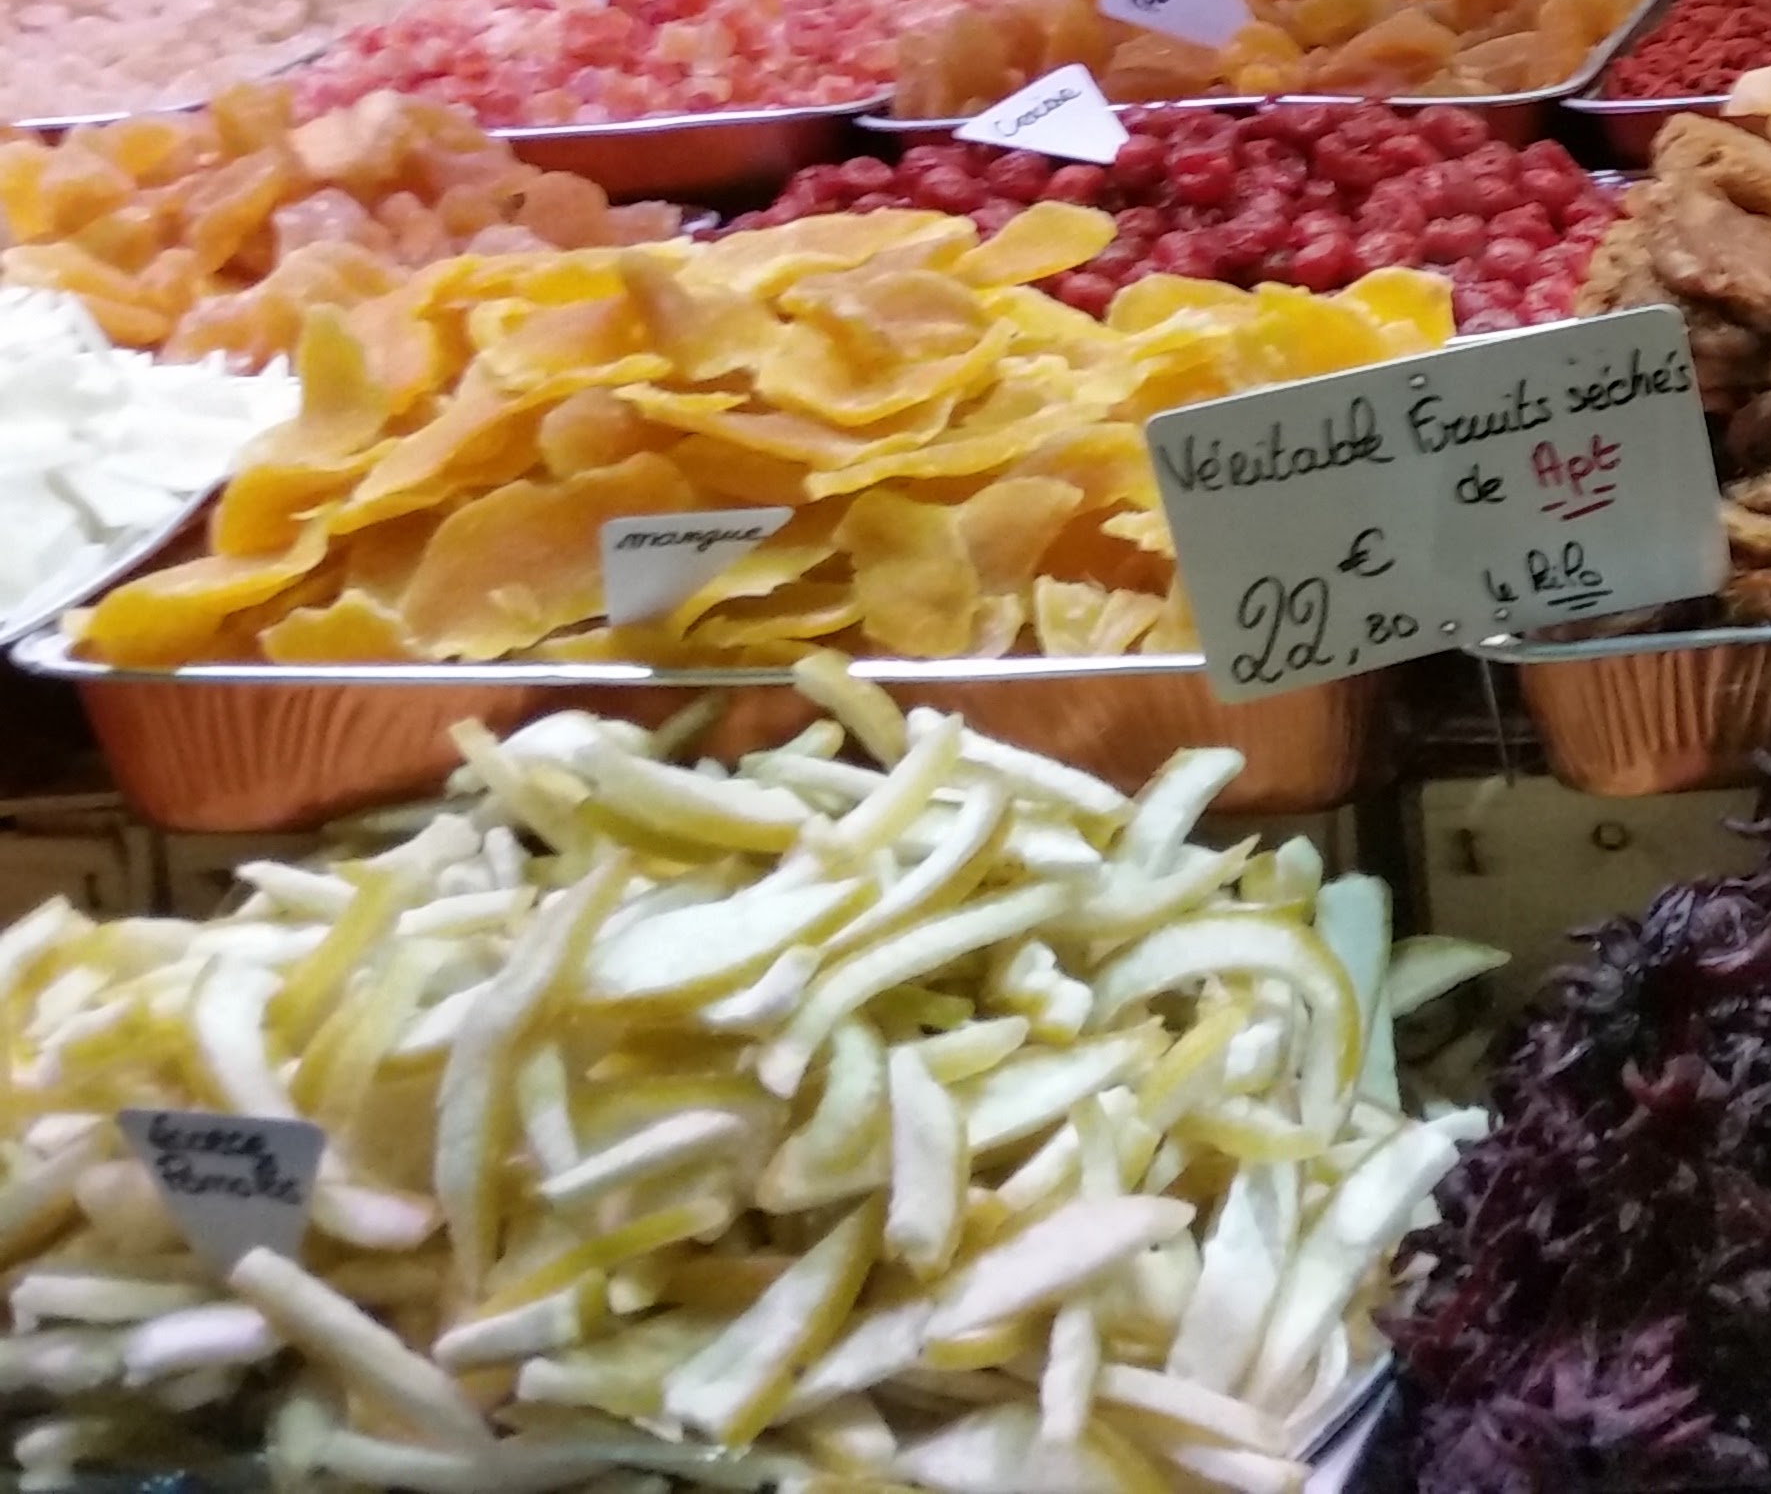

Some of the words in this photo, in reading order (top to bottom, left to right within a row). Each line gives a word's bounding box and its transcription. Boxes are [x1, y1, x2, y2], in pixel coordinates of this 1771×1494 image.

[1156, 395, 1397, 492] Véritable
[1407, 378, 1552, 454] Fruits
[1567, 349, 1692, 414] séchés
[1456, 463, 1507, 505] de
[1531, 434, 1622, 497] Apt
[615, 526, 771, 552] mangue
